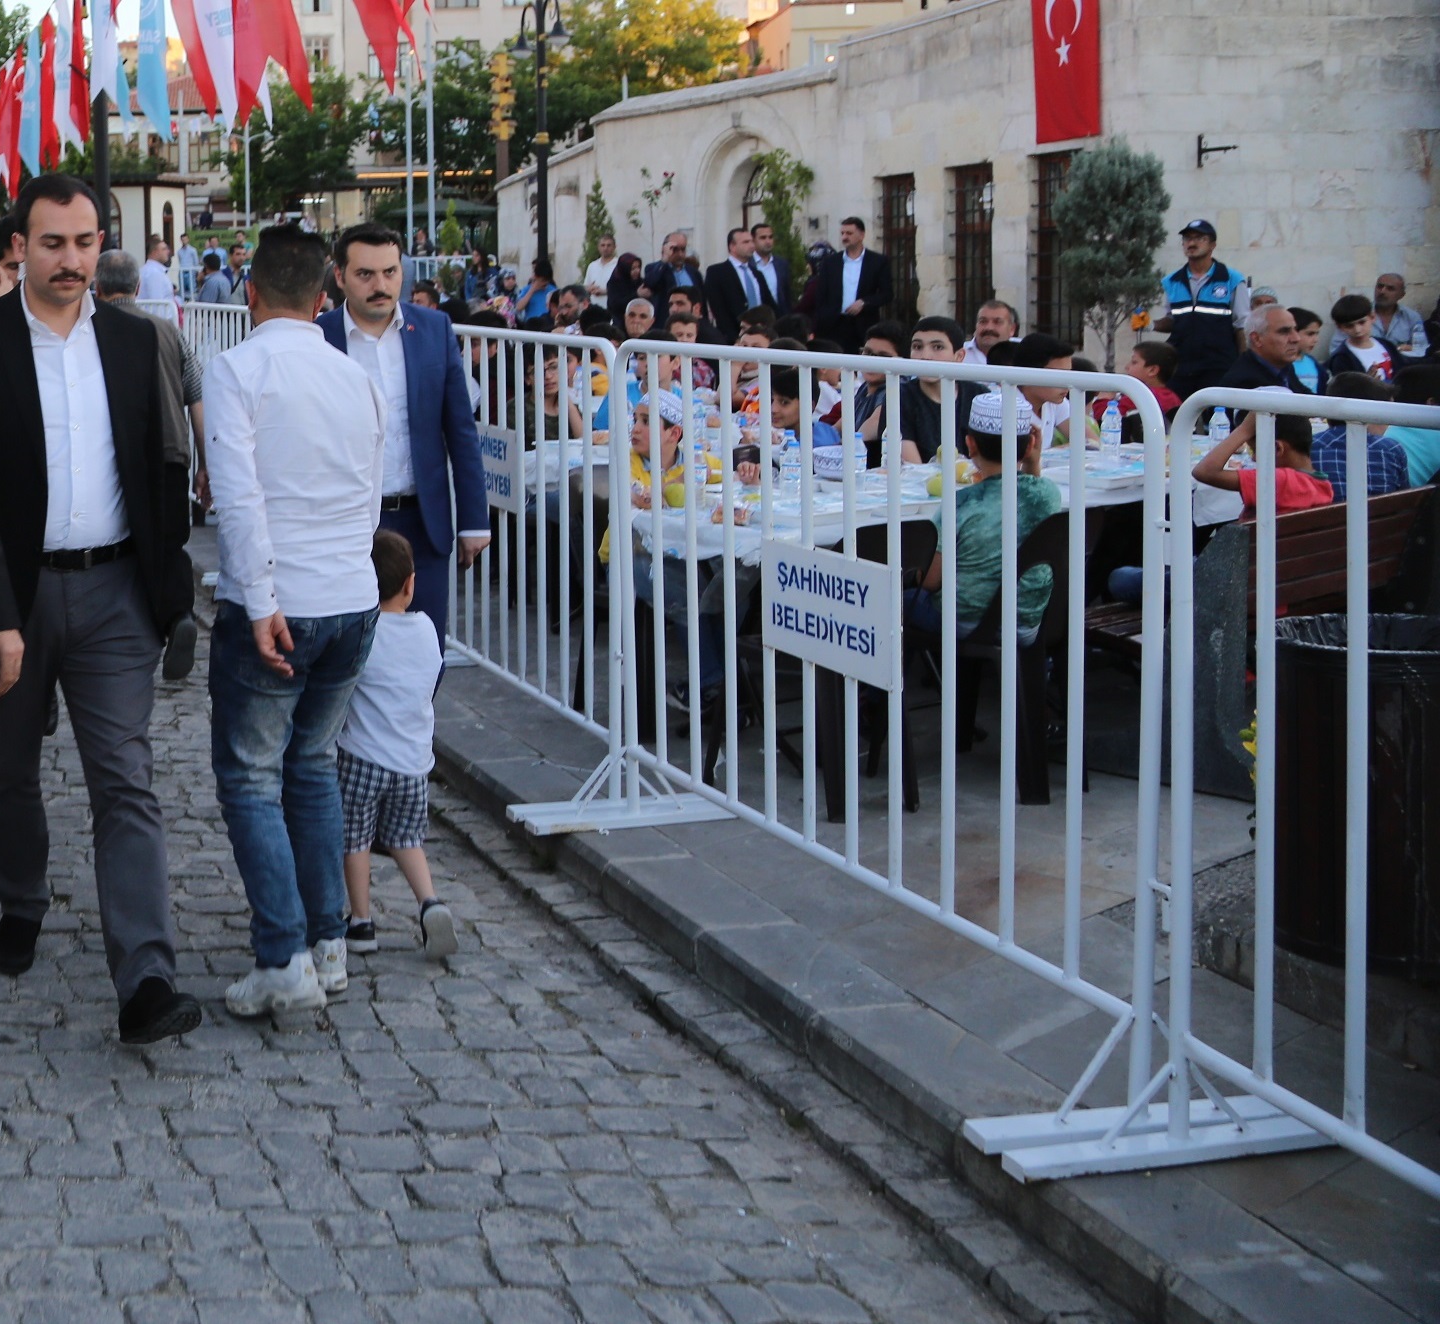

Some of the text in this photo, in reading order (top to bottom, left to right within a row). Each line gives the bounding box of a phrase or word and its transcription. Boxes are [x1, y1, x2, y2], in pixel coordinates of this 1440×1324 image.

[480, 431, 507, 461] HİNBEY
[777, 561, 869, 608] ŞAHİNBEY
[772, 602, 875, 657] BELEDİYESİ
